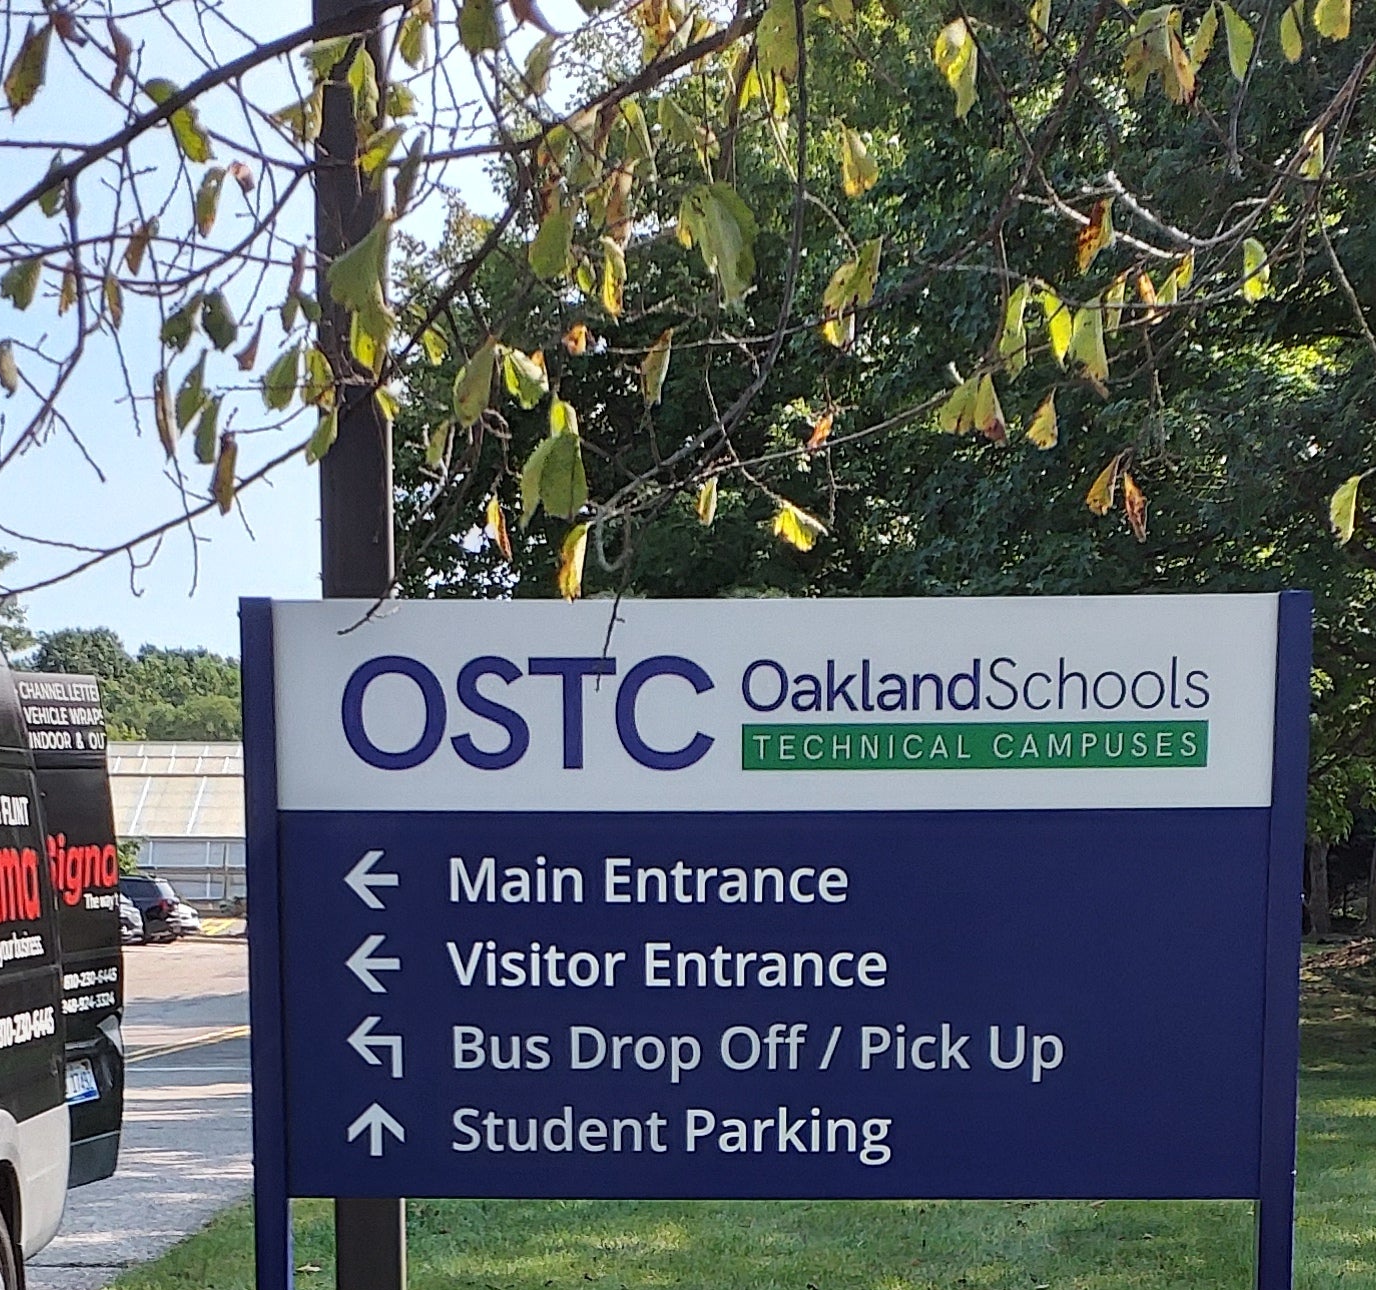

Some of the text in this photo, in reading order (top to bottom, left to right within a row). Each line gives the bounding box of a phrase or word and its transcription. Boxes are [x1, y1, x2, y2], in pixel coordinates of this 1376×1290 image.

[18, 681, 69, 701] CHANNEL
[741, 656, 1210, 713] OaklandSchools
[23, 706, 69, 726] VEHICLE
[341, 654, 715, 771] OSTC
[28, 731, 72, 750] INDOOR
[75, 732, 85, 750] &
[752, 732, 1197, 760] TECHNICAL CAMPUSES
[0, 795, 29, 827] FLINT
[450, 855, 848, 904] Main Entrance
[446, 939, 887, 988] Visitor Entrance
[453, 1022, 1064, 1084] Bus Drop Off / Pick Up
[452, 1105, 892, 1166] Student Parking
